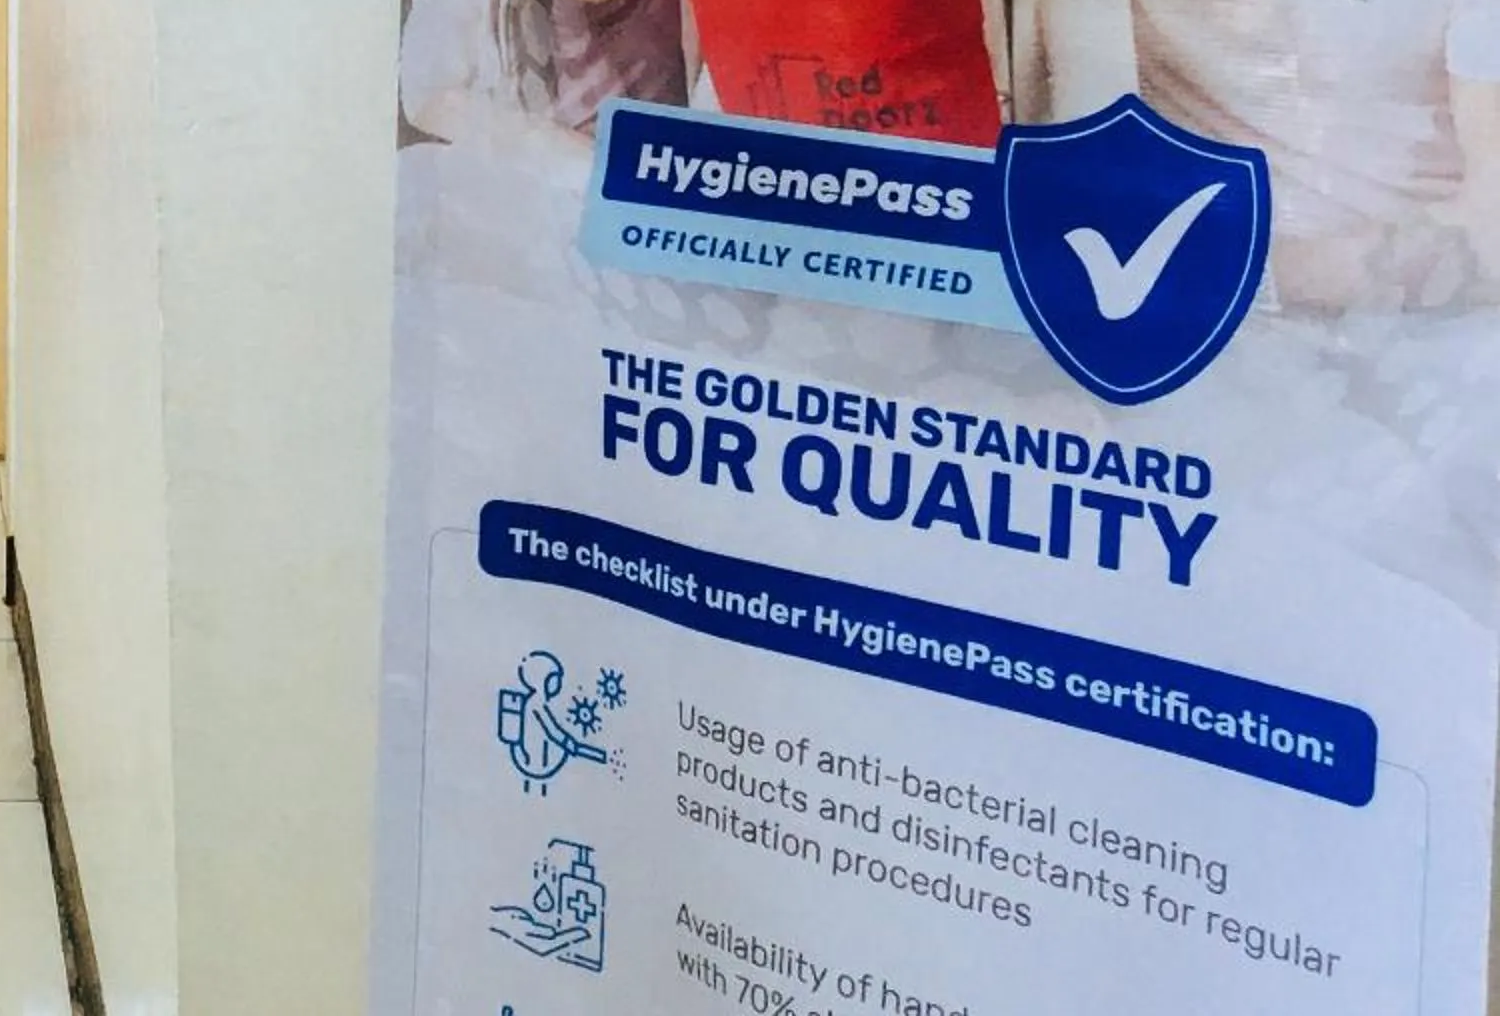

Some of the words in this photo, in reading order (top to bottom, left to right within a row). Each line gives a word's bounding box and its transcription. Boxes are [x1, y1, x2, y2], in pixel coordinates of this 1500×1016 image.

[635, 142, 974, 222] HygienePass
[621, 224, 792, 269] OFFICIALLY
[803, 251, 973, 296] CERTIFIED
[602, 349, 684, 399] THE
[696, 369, 897, 440] GOLDEN
[910, 407, 1212, 499] STANDARD
[602, 394, 758, 494] FOR
[781, 435, 1219, 587] QUALITY
[508, 527, 569, 561] The
[575, 543, 698, 603] checklist
[705, 587, 807, 629] under
[814, 605, 1056, 690] HygienePass
[1065, 673, 1335, 767] certification:
[676, 793, 822, 864] sanitation
[832, 846, 1033, 927] procedures
[677, 750, 808, 813] products
[819, 798, 882, 833] and
[892, 813, 1130, 908] disinfectants
[1142, 884, 1196, 926] for
[1206, 910, 1341, 977] regular
[678, 701, 765, 755] Usage
[775, 738, 810, 767] of
[817, 751, 1057, 836] anti-bacterial
[1068, 818, 1228, 896] cleaning
[676, 902, 828, 993] Availability
[837, 973, 874, 1003] of
[881, 980, 970, 1016] han
[677, 950, 728, 995] with
